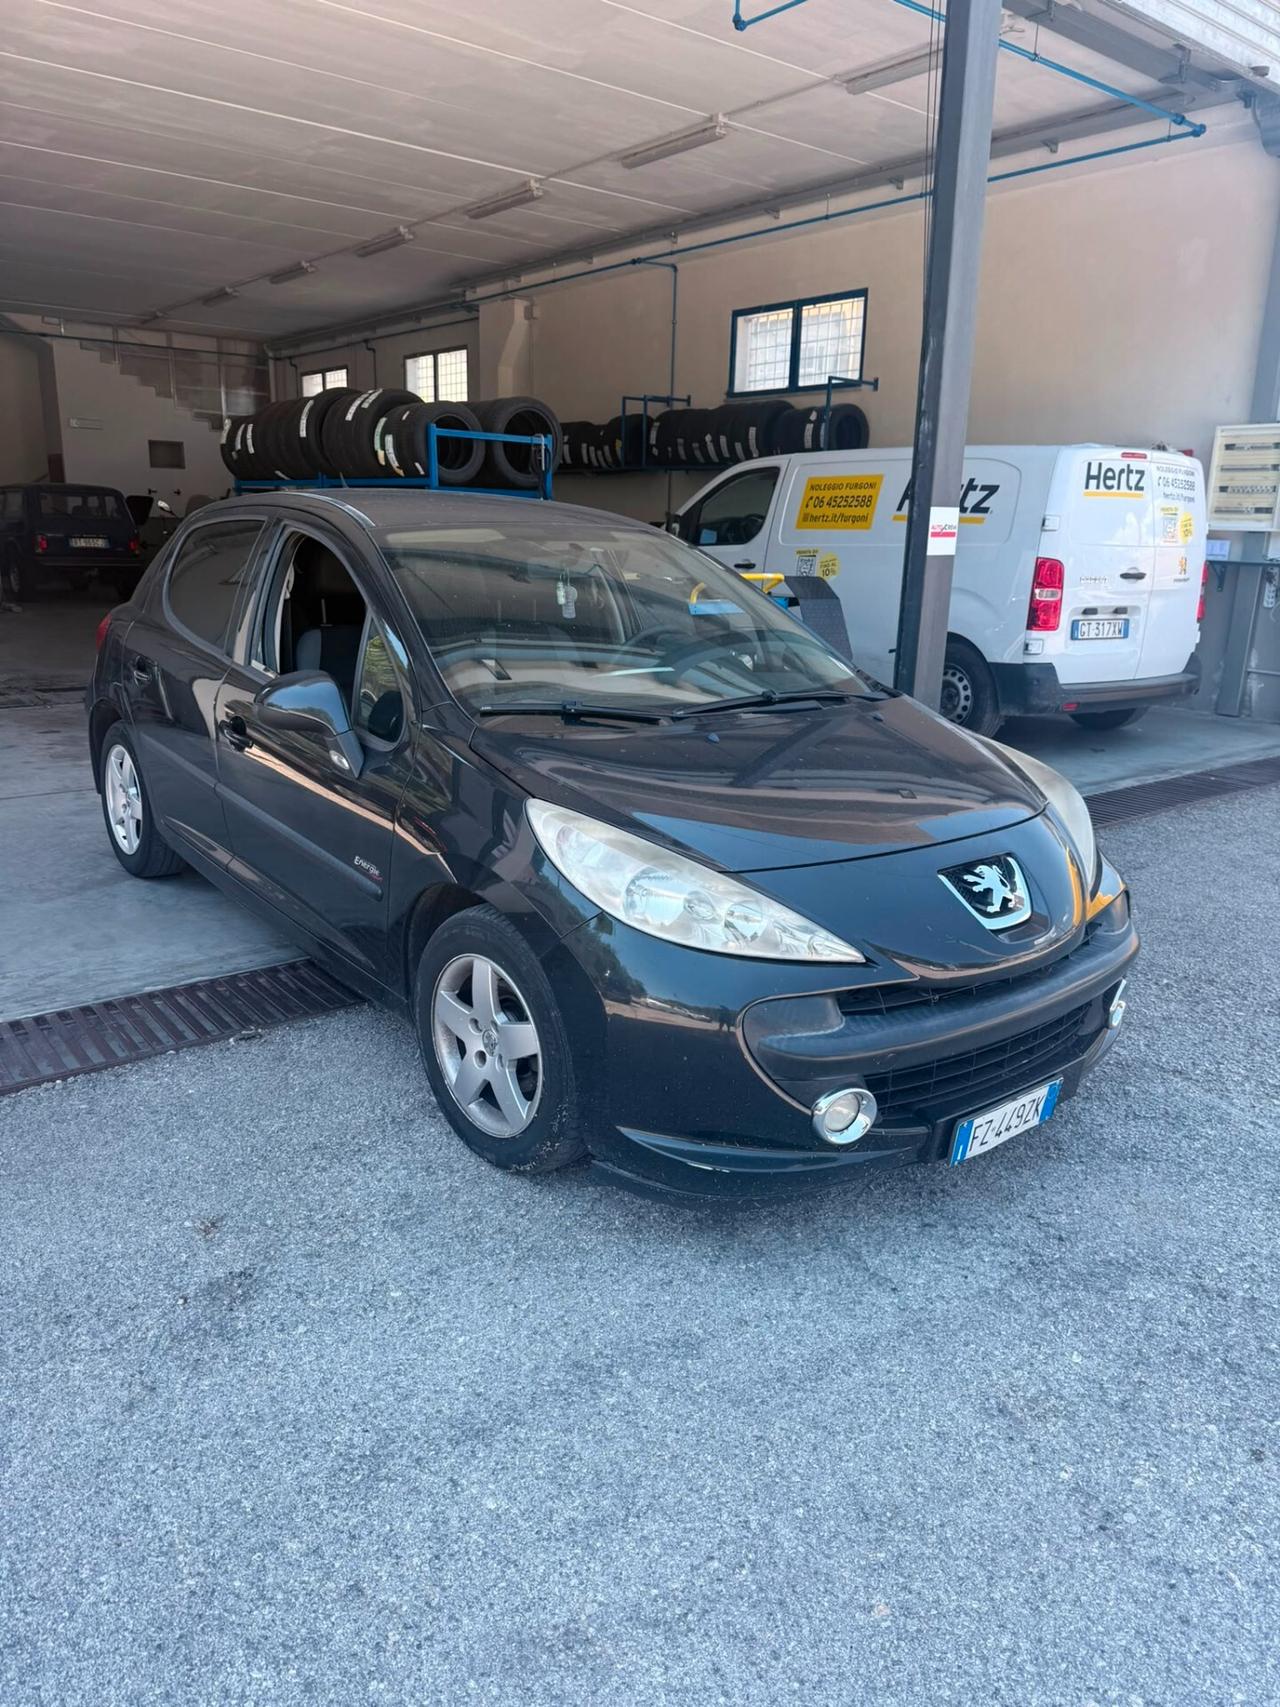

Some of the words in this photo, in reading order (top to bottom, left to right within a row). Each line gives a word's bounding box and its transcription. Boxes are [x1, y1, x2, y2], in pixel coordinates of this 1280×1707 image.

[1084, 461, 1146, 492] Hertz
[810, 483, 845, 492] NOLEGGIO
[845, 481, 877, 491] FURGONI
[813, 495, 825, 509] 06
[826, 495, 873, 509] 45252588
[809, 512, 869, 524] hertz.it/furgoni
